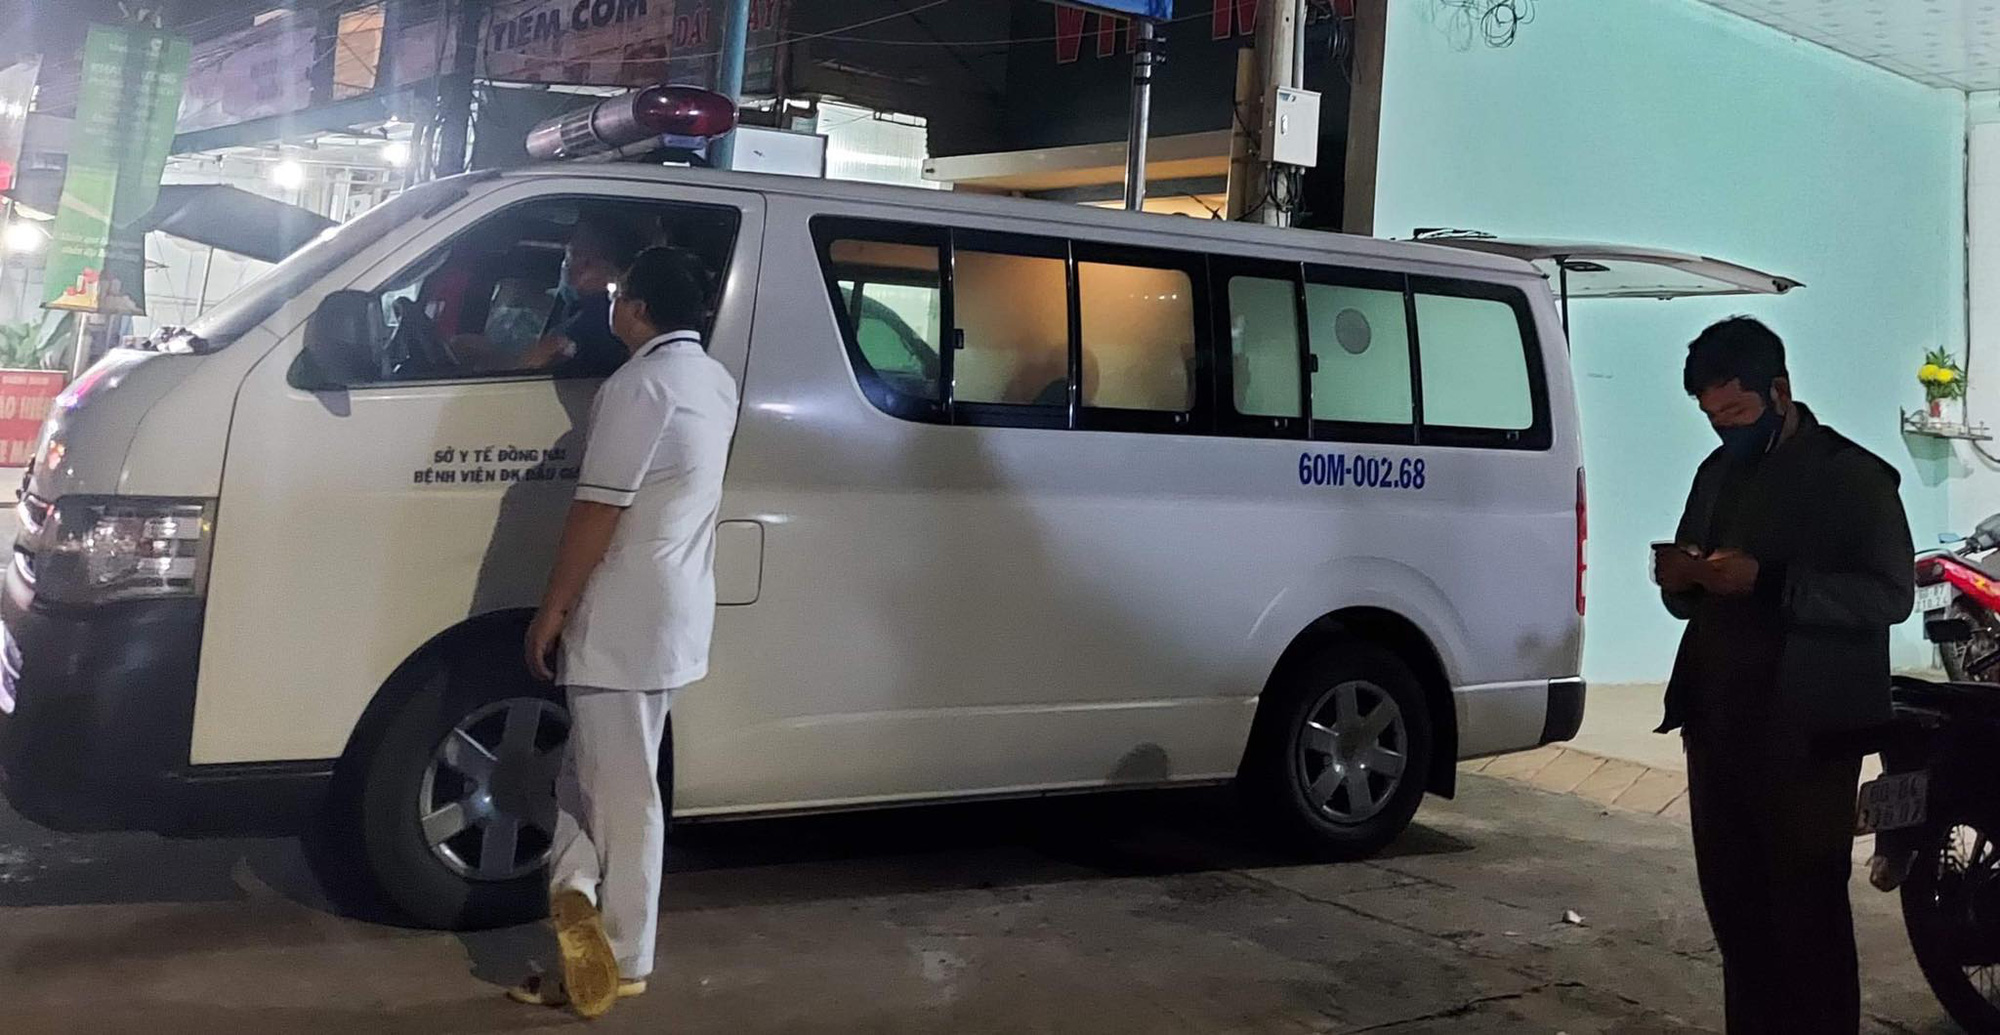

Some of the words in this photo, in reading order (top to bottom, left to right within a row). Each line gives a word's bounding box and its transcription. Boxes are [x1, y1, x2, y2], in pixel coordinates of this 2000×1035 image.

[459, 449, 469, 463] Y
[473, 445, 495, 462] TẾ
[498, 445, 538, 462] ĐỒNG
[414, 466, 455, 485] BỆNH
[460, 466, 496, 483] VIỆN
[1299, 453, 1425, 489] 60M-002.68
